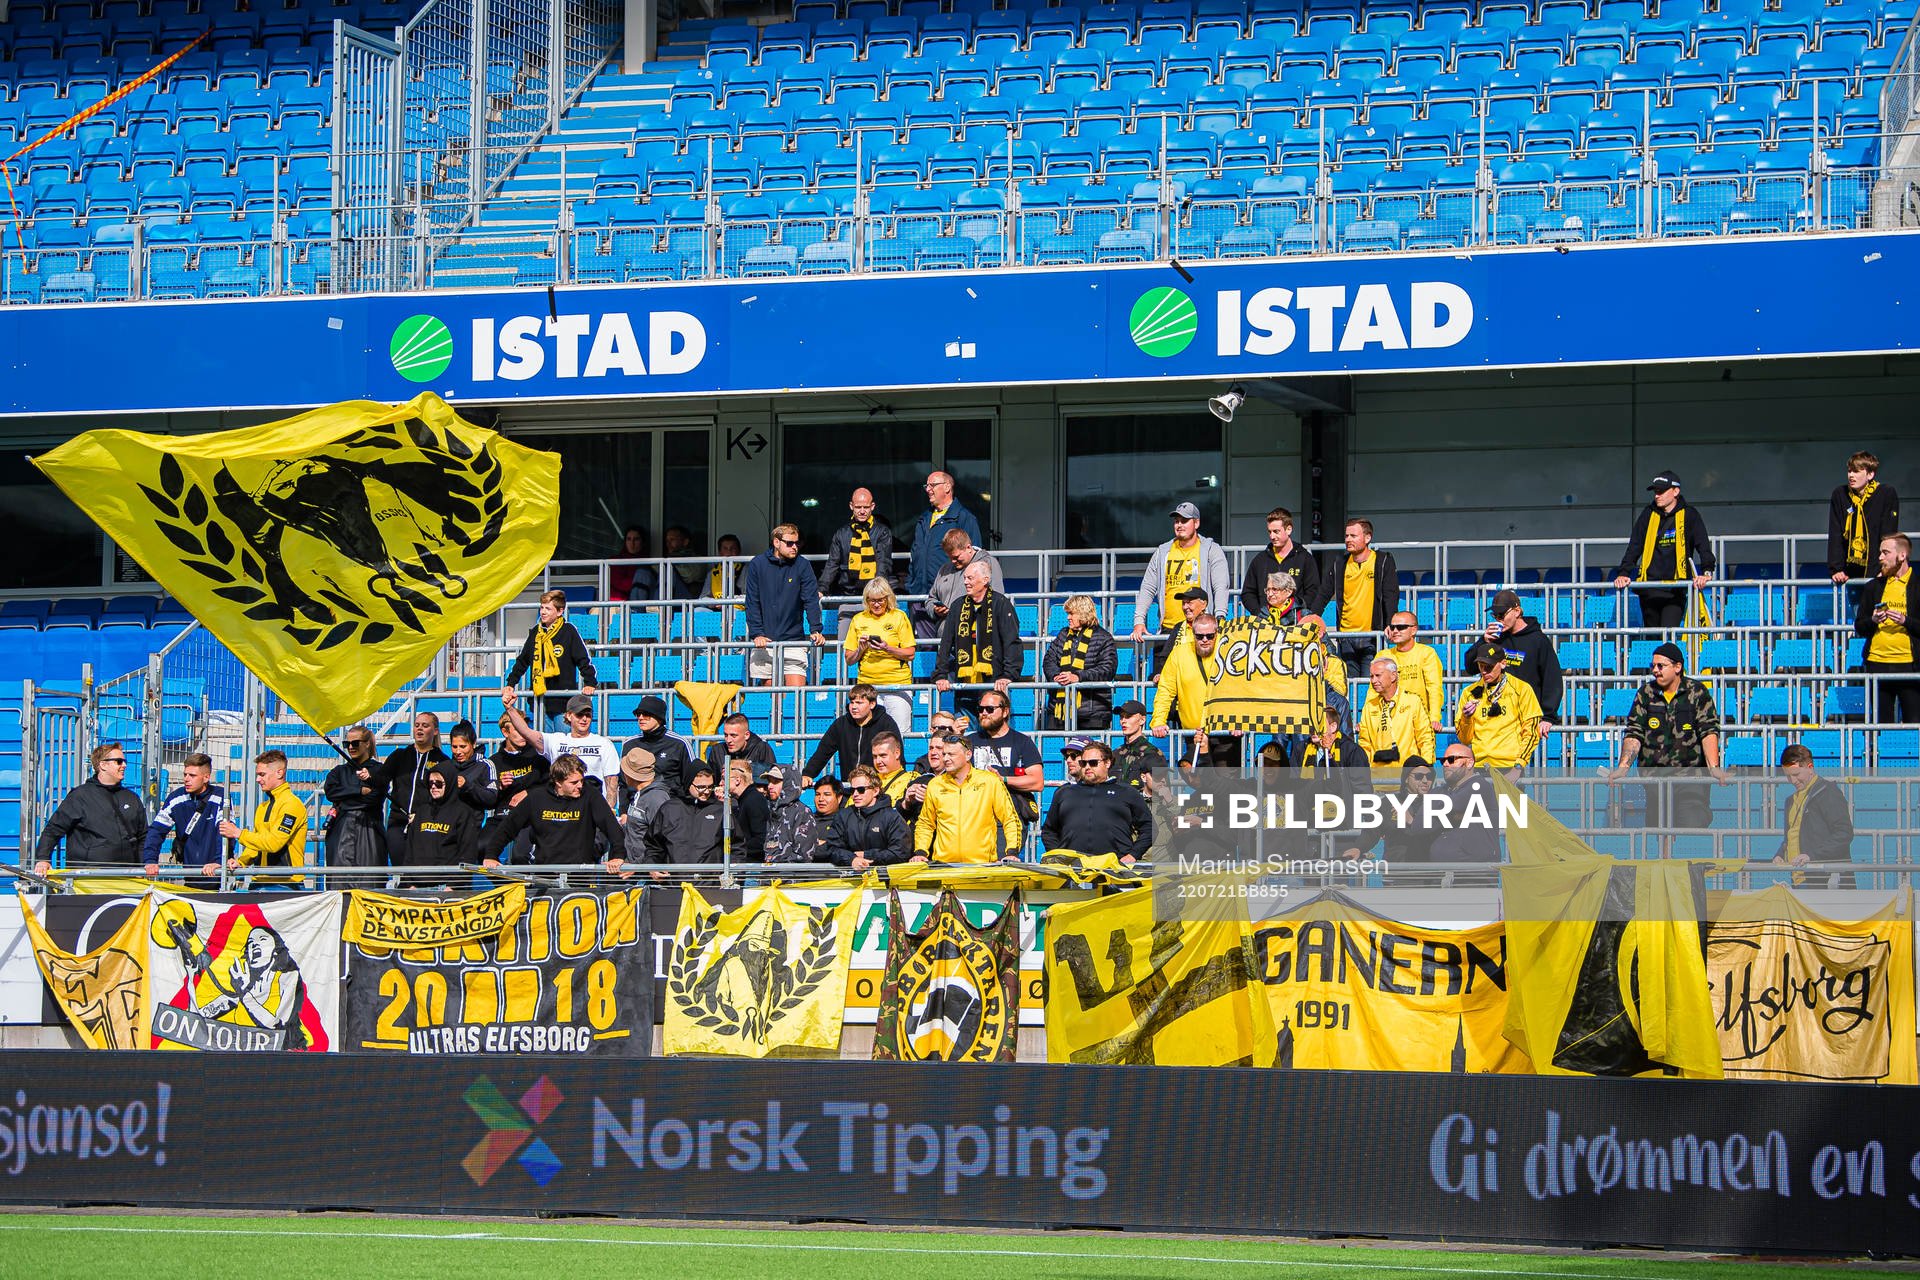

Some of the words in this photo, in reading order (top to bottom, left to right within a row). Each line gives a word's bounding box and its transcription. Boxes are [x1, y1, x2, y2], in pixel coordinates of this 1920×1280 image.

[1217, 281, 1475, 357] ISTAD
[472, 311, 707, 382] ISTAD
[727, 427, 752, 460] K
[1167, 559, 1185, 575] 17
[558, 745, 600, 754] ULRAS
[542, 810, 572, 819] SEKTION
[574, 810, 580, 818] U
[363, 901, 454, 926] SYMPATI
[463, 893, 506, 918] FÖR
[363, 921, 389, 938] DE
[389, 911, 505, 941] AVSTÄNGDA
[552, 959, 618, 1031] 18
[158, 1010, 200, 1042] ON
[205, 1023, 280, 1052] TOUR!
[1295, 1000, 1350, 1030] 1991
[410, 1026, 480, 1055] ULTRAS
[485, 1025, 591, 1052] ELFSBORG
[593, 1097, 810, 1172] Norsk
[823, 1101, 1110, 1199] Tipping
[1429, 1112, 1500, 1200] Gi
[1524, 1110, 1791, 1200] drømmen
[1811, 1140, 1886, 1200] en
